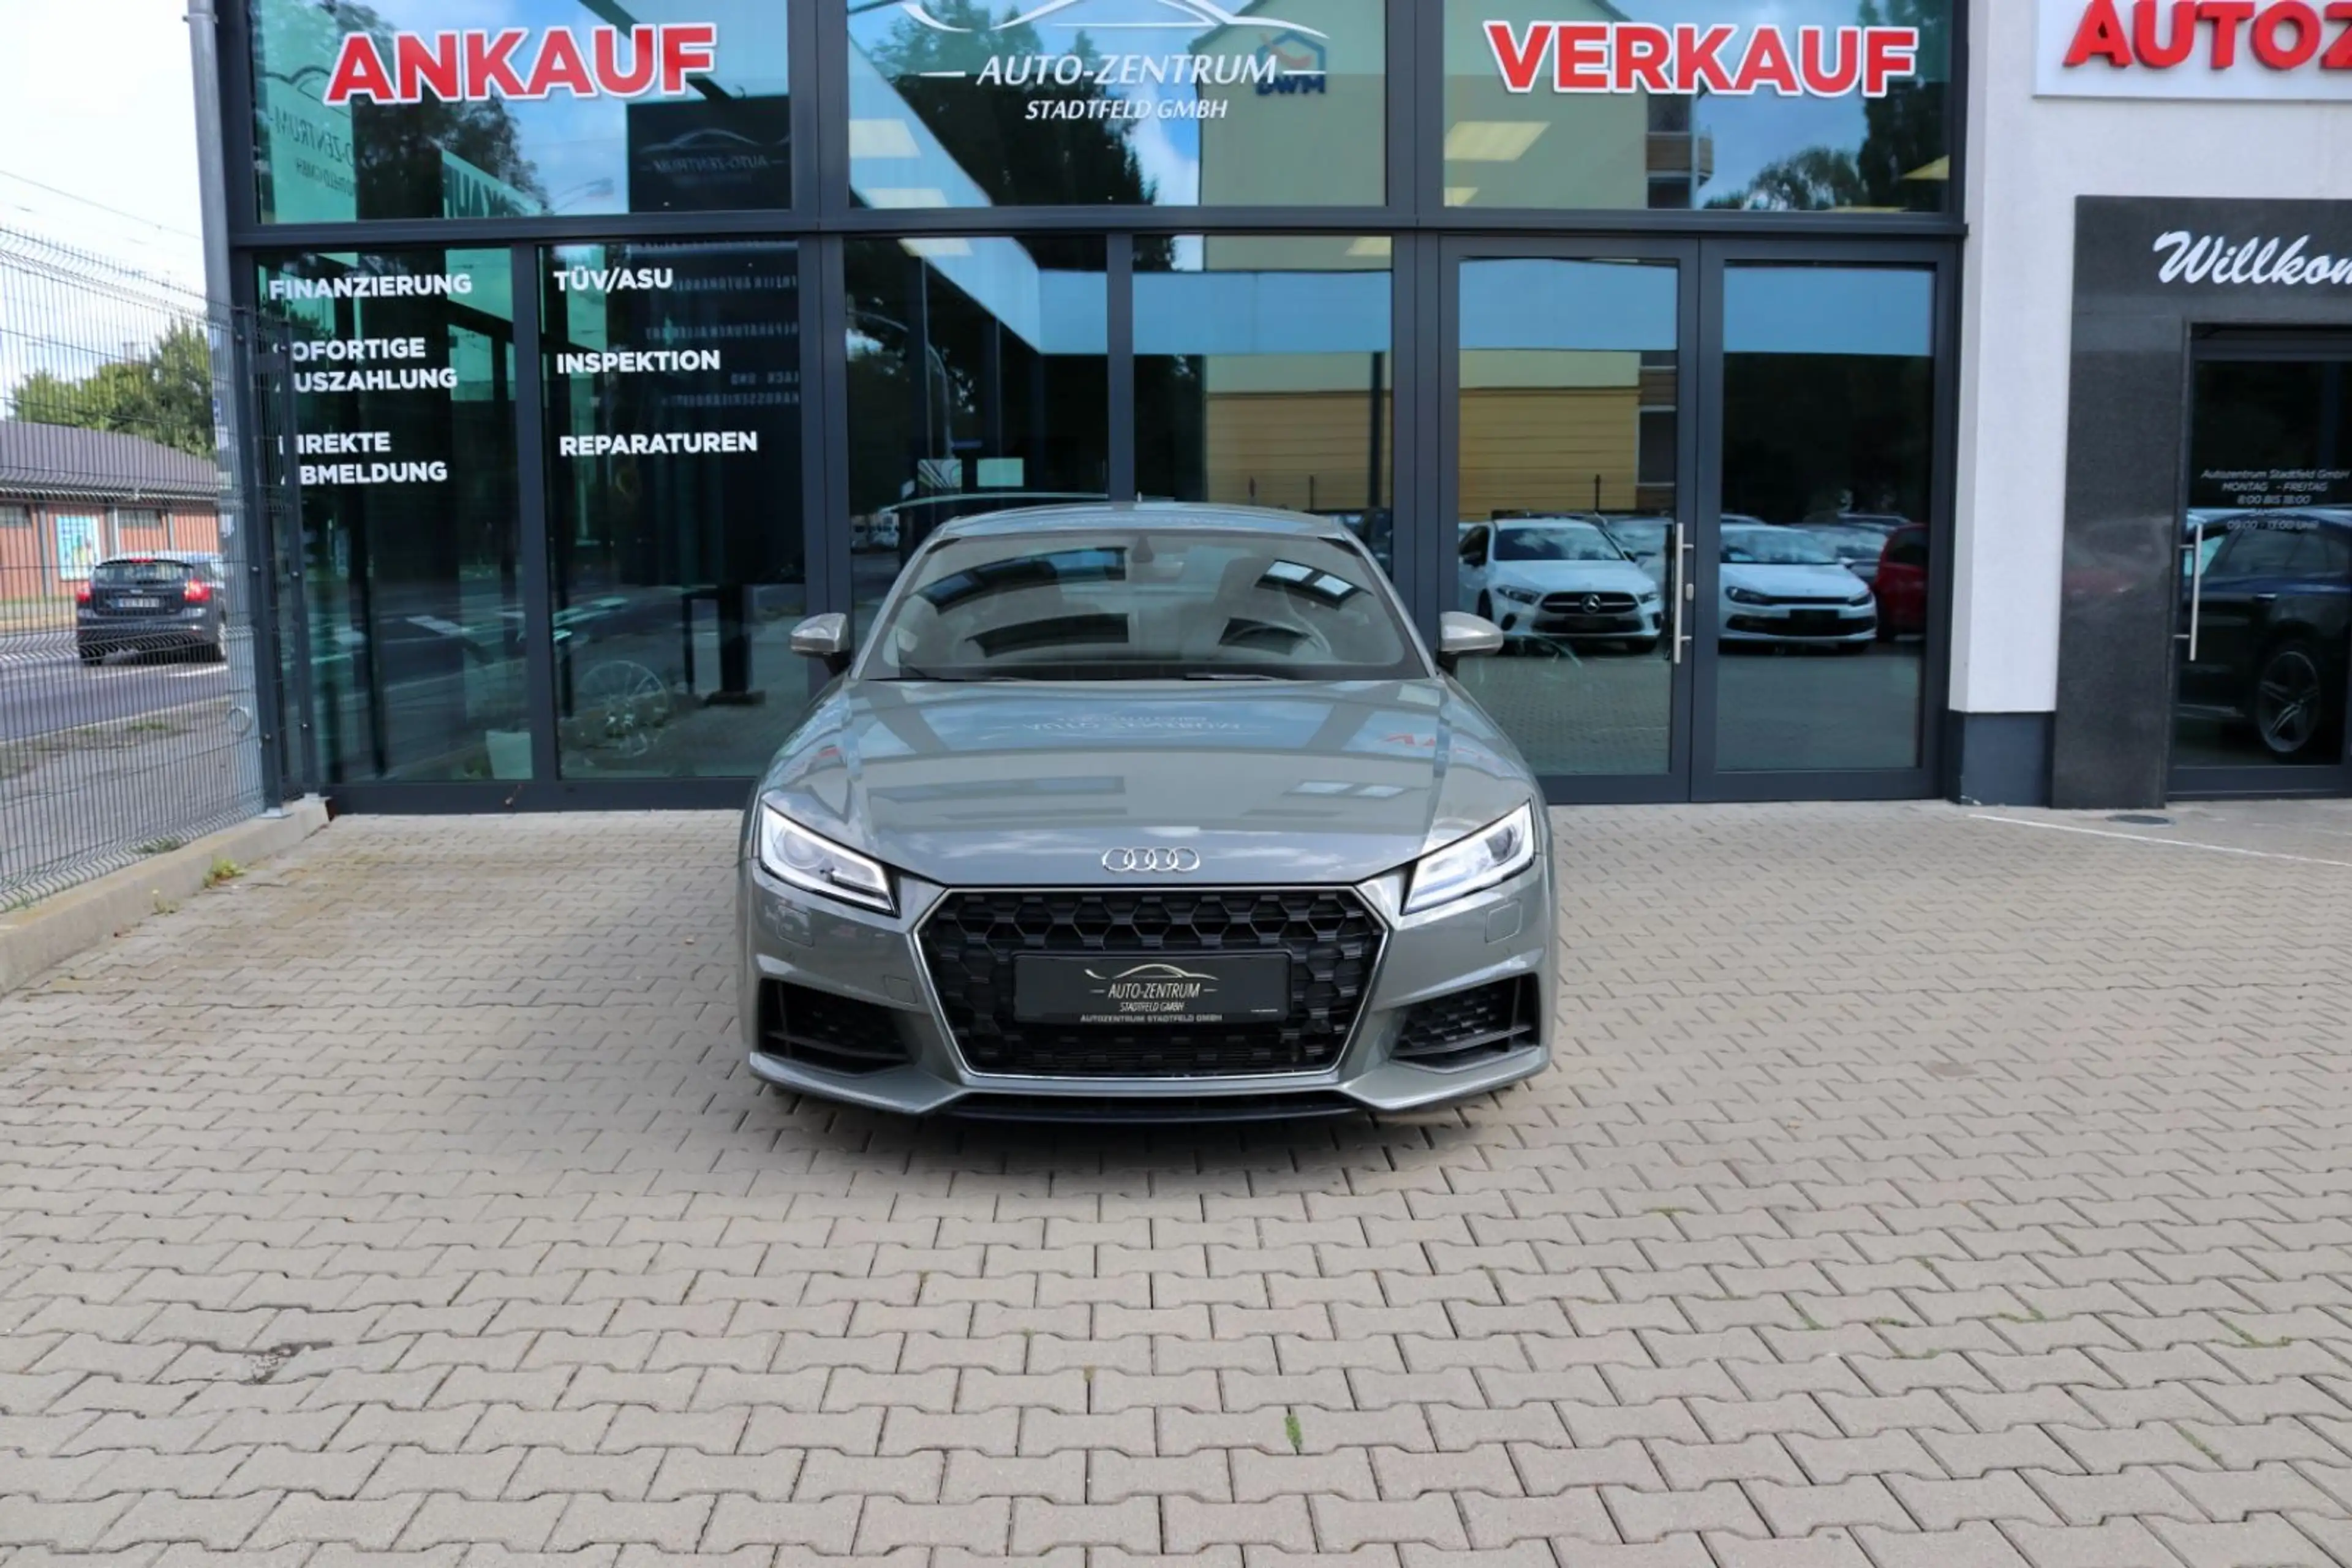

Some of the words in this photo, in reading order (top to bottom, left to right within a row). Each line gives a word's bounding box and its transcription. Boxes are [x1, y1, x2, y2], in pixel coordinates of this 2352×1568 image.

[323, 21, 717, 105] ANKAUF
[976, 54, 1278, 87] AUTO-ZENTRUM
[1484, 21, 1919, 98] VERKAUF
[1025, 99, 1152, 121] STADTFELD
[1157, 99, 1228, 120] GMBH
[269, 274, 472, 300] FINANZIERUNG
[554, 266, 673, 294] TÜV/ASU
[557, 350, 720, 374] INSPEKTION
[274, 368, 458, 393] USZAHLUNG
[278, 432, 391, 454] IREKTE
[560, 431, 758, 456] REPARATUREN
[281, 461, 448, 485] BMELDUNG
[1108, 982, 1200, 999] AUTO-ZENTRUM
[1080, 1014, 1145, 1022] AUTOZENTRUM
[1147, 1014, 1194, 1022] STADTFELD
[1196, 1014, 1223, 1022] GMBH
[1120, 1002, 1158, 1012] STADTFELD
